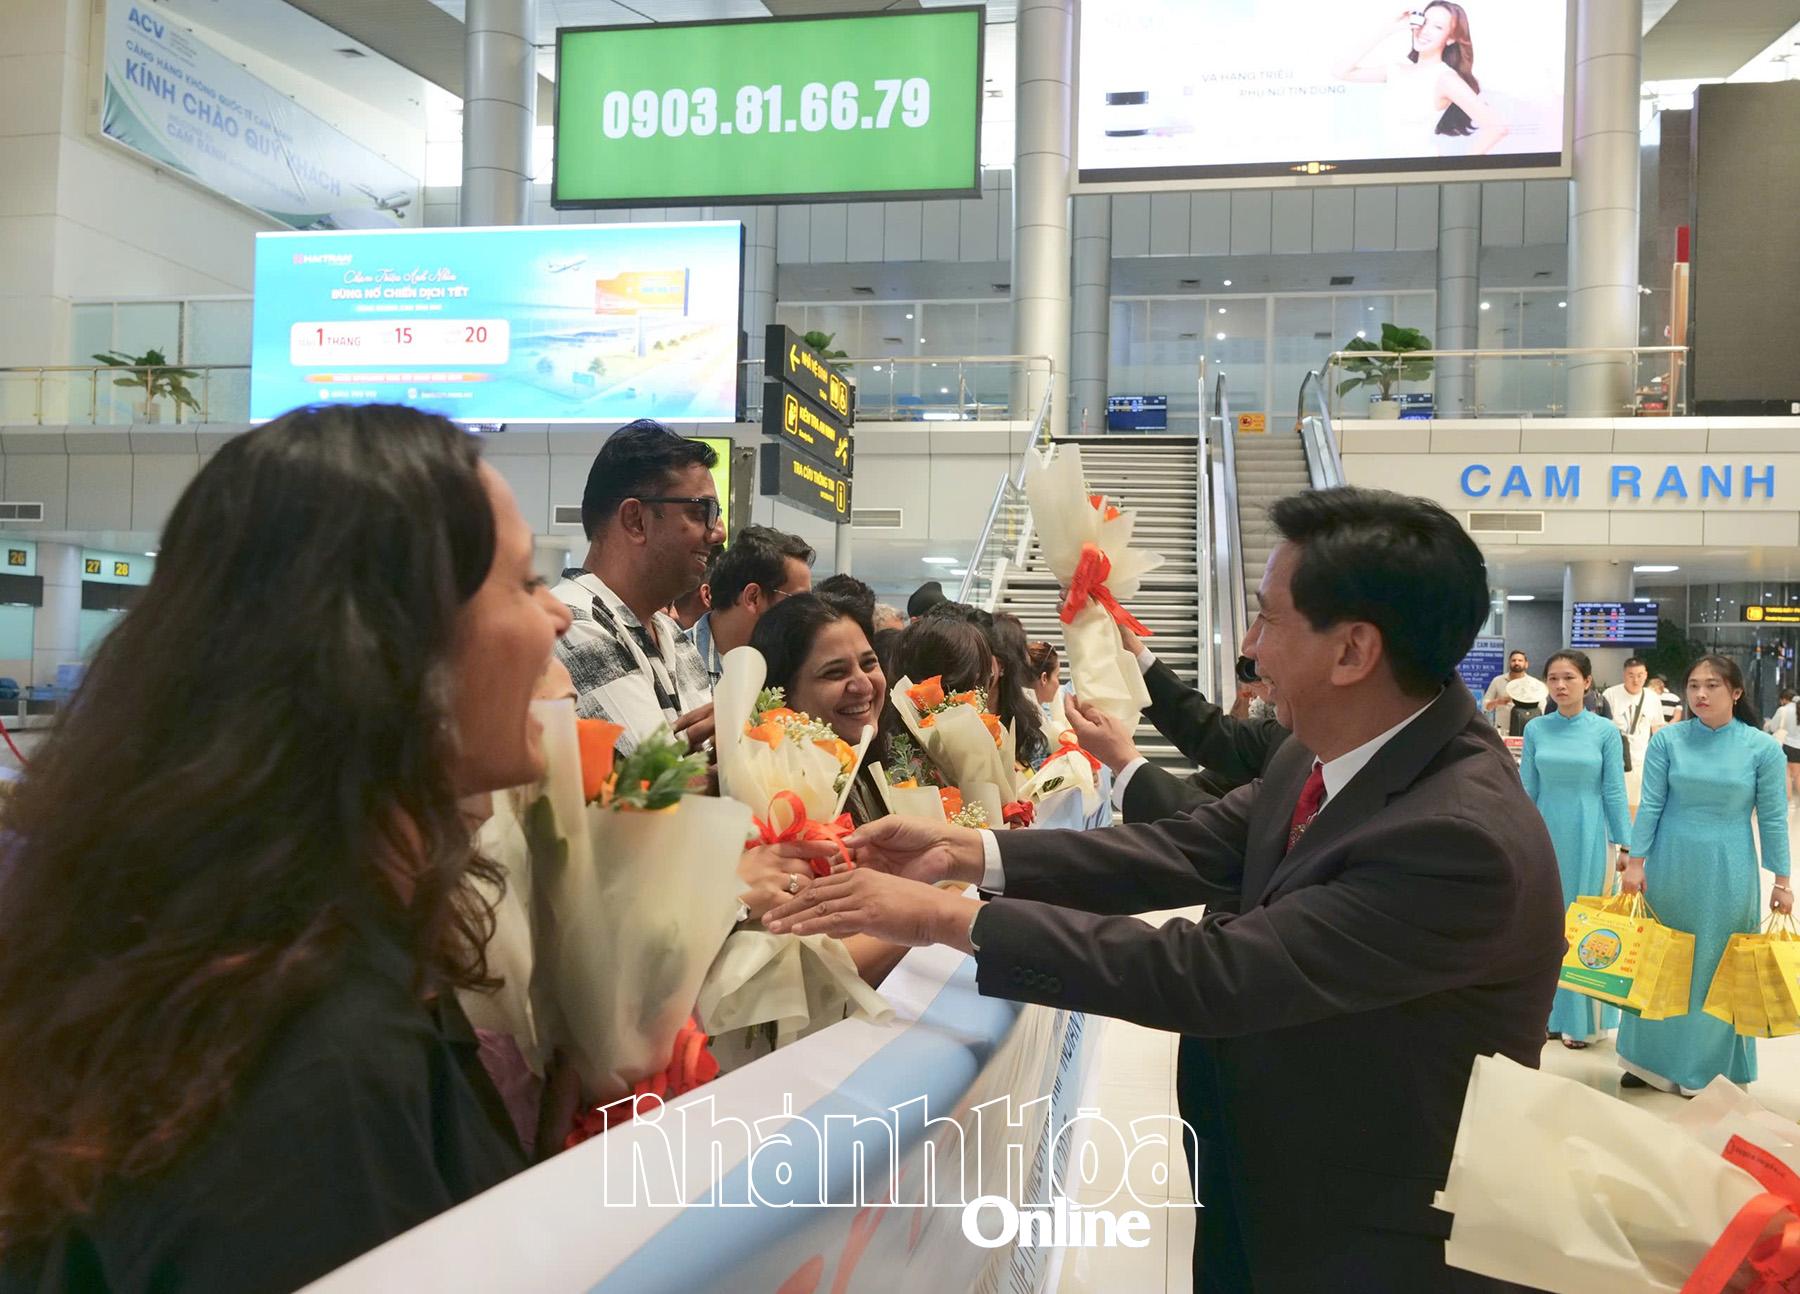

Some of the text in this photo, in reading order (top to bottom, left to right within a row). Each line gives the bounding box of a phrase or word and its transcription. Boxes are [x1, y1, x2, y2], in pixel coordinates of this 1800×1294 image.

[129, 7, 164, 39] ACV
[126, 58, 176, 105] KÍNH
[183, 92, 239, 138] CHÀO
[602, 77, 931, 139] 0903.81.66.79
[316, 327, 325, 347] 1
[395, 327, 413, 345] 15
[465, 326, 487, 343] 20
[1460, 464, 1775, 498] CAM RANH
[88, 561, 99, 573] 27
